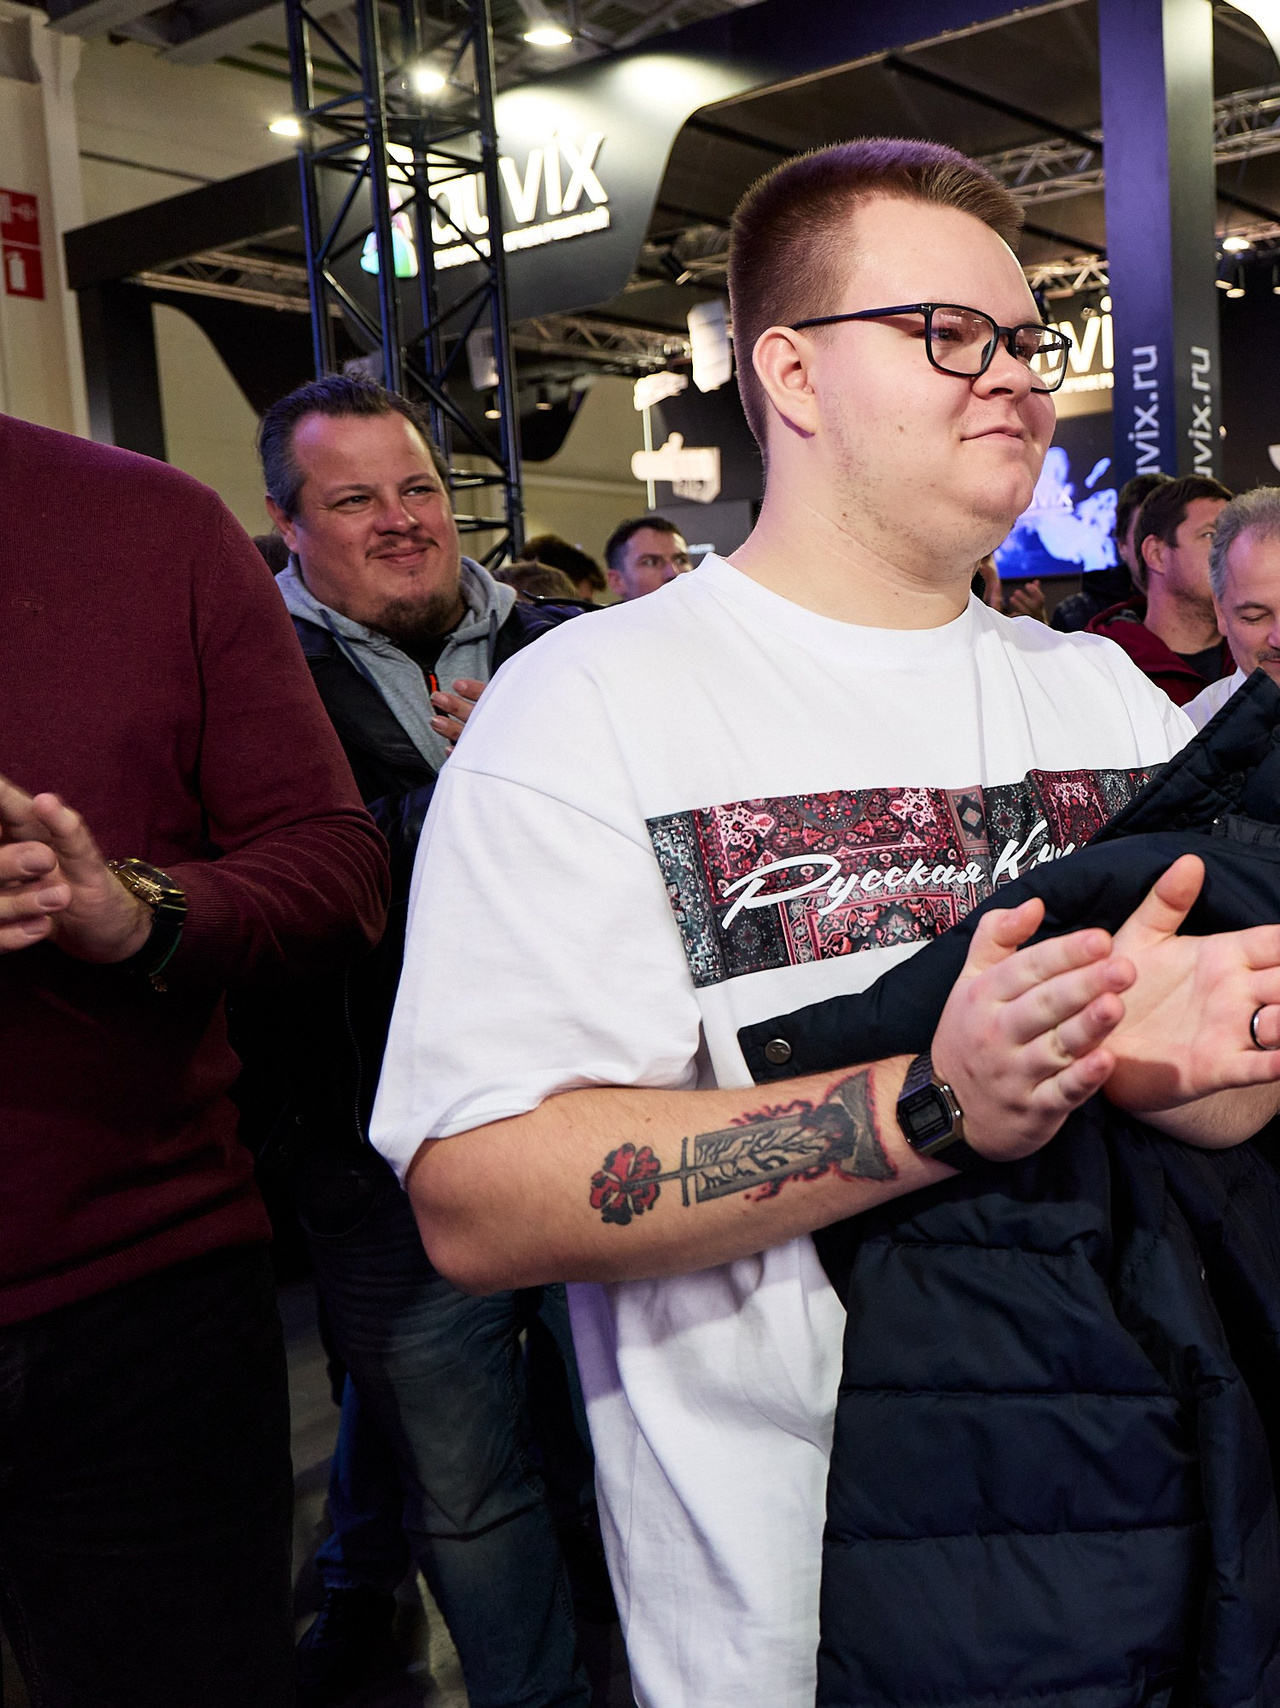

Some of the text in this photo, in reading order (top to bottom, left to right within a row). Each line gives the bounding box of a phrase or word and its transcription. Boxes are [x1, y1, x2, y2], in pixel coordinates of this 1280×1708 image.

[1128, 345, 1162, 475] vix.ru
[1188, 346, 1213, 478] vix.ru
[721, 853, 985, 930] Русская
